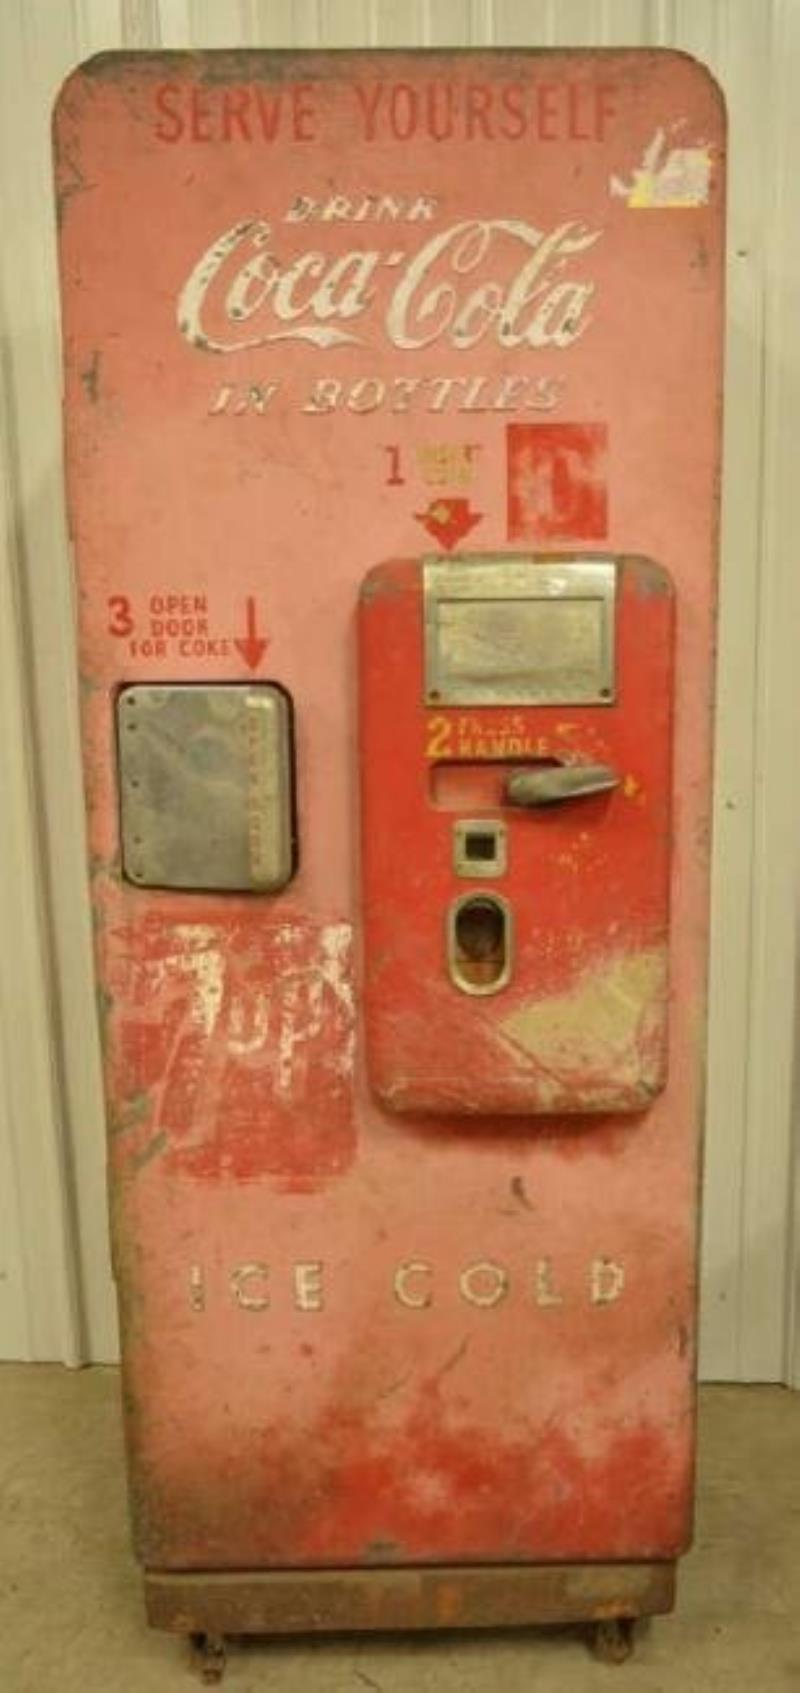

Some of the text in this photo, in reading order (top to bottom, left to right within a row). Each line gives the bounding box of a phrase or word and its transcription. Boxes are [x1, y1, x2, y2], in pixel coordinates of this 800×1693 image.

[155, 82, 620, 144] SERVE YOURSELF
[285, 195, 439, 224] DRINK
[177, 219, 603, 353] Coca-Cola
[207, 375, 567, 417] IN BOTTLES
[107, 595, 135, 639] 3
[150, 594, 209, 616] OPEN
[150, 617, 209, 638] DOOR
[425, 715, 453, 759] 2
[457, 736, 550, 758] HANDLE
[189, 1256, 626, 1312] ICE COLD
